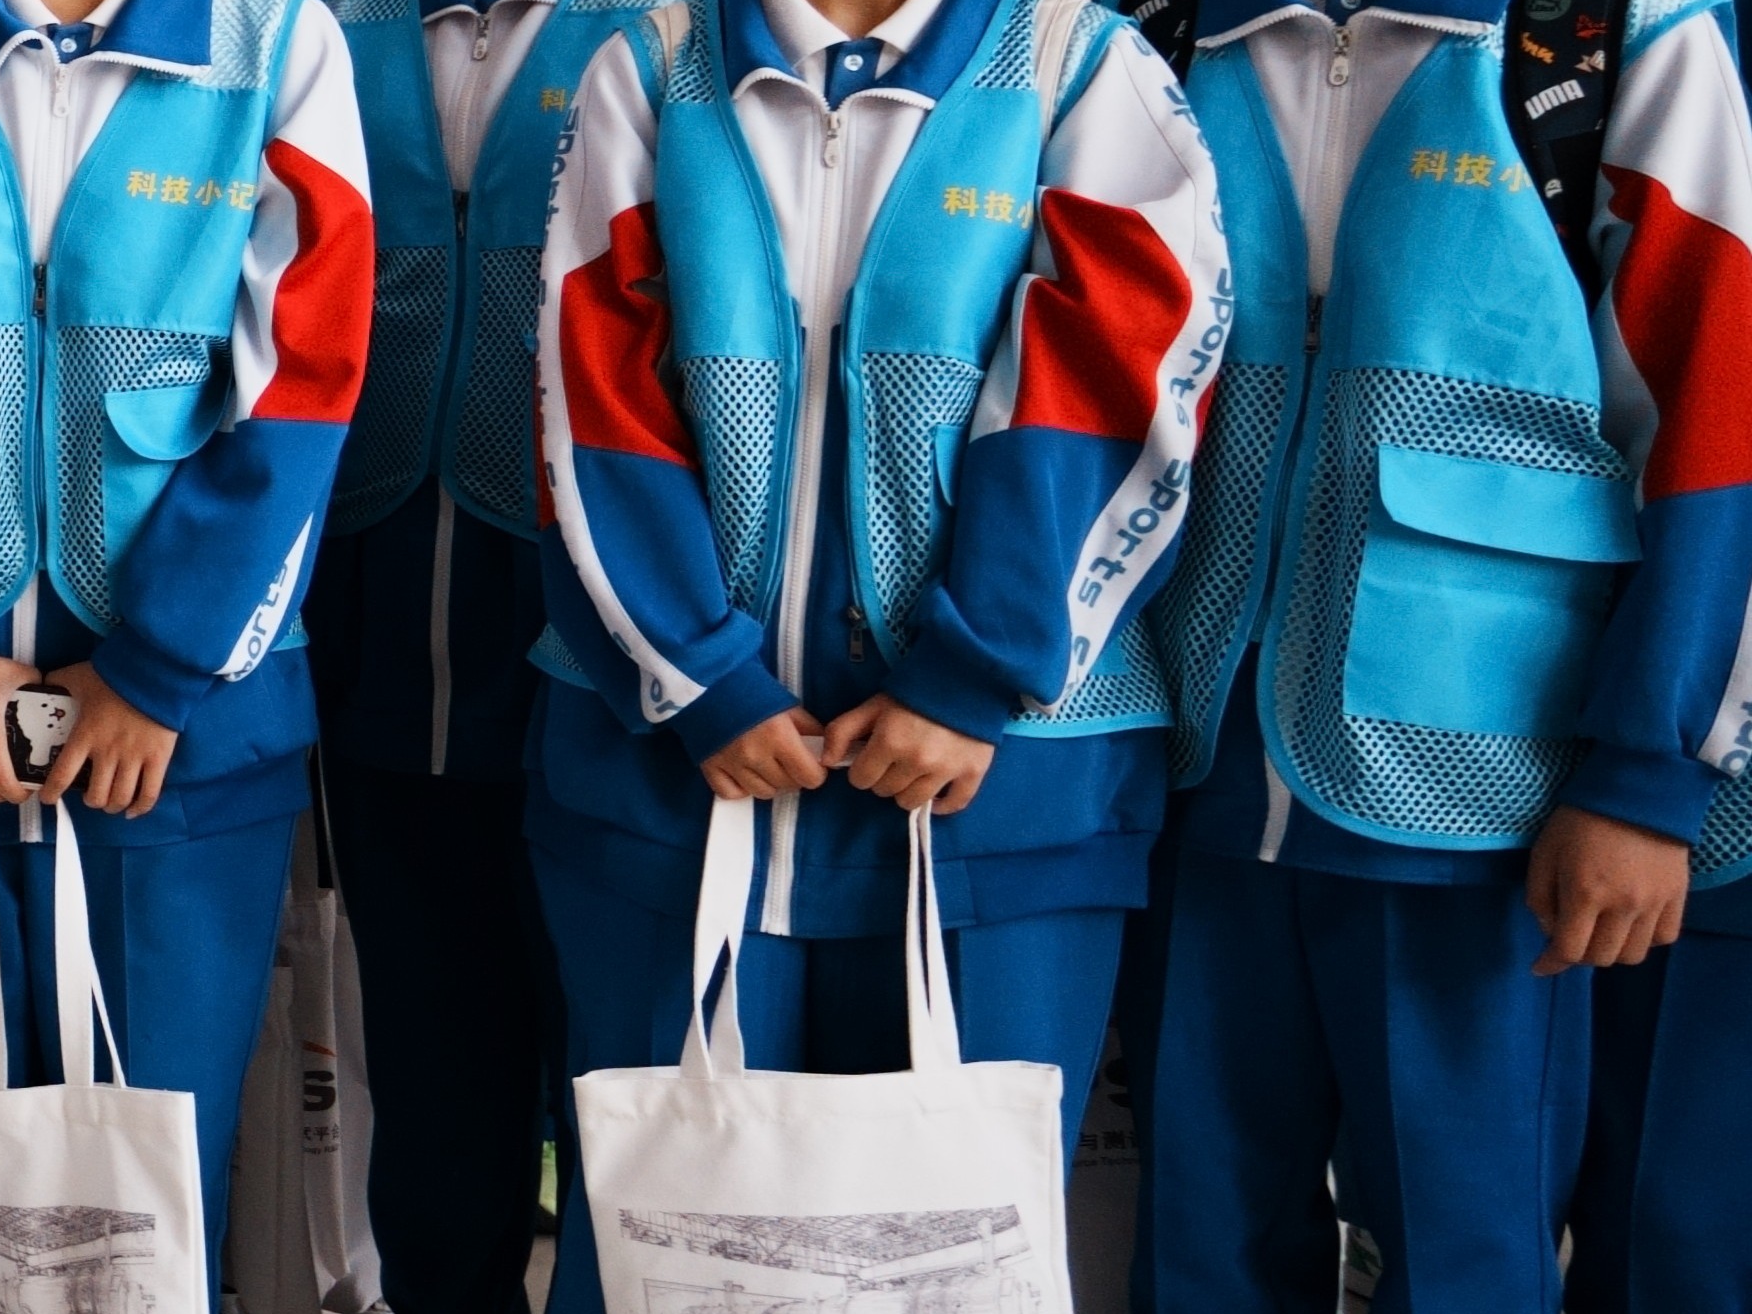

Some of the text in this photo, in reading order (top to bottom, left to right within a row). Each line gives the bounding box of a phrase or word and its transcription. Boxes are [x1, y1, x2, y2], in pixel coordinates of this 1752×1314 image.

[127, 170, 255, 211] 科技小记
[1077, 458, 1193, 609] Sports
